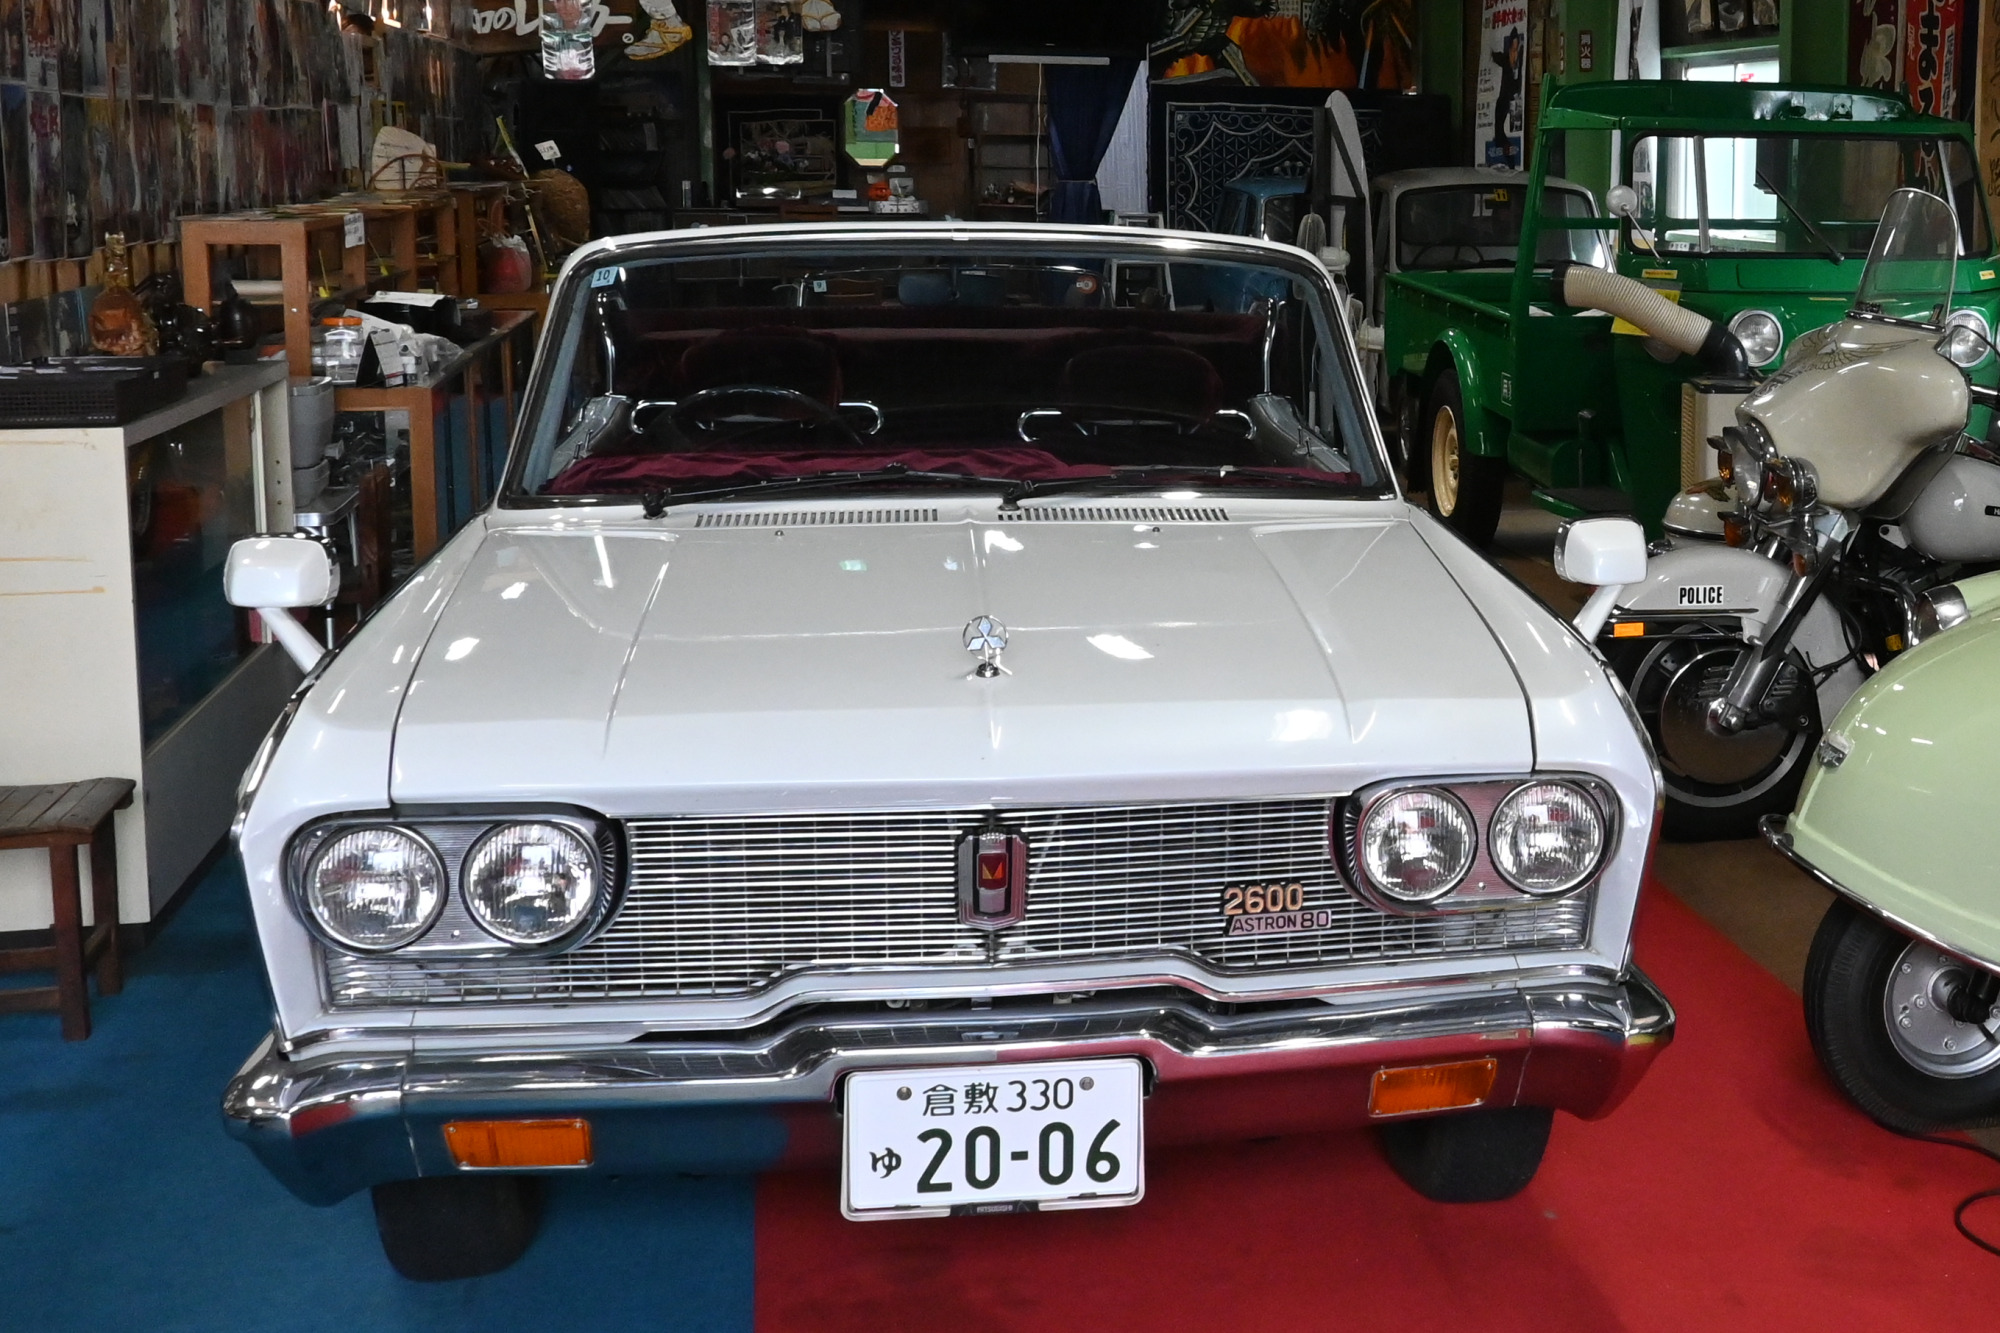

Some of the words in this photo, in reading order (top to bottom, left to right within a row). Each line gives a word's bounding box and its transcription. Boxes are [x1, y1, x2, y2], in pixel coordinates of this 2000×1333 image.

[1580, 33, 1591, 69] 消火器
[596, 269, 611, 282] 10
[1679, 586, 1722, 604] POLICE
[1223, 883, 1303, 915] 2600
[1231, 915, 1297, 933] ASTRON
[1300, 910, 1330, 928] 80
[869, 1147, 902, 1178] ゆ
[917, 1119, 1121, 1193] 20-06
